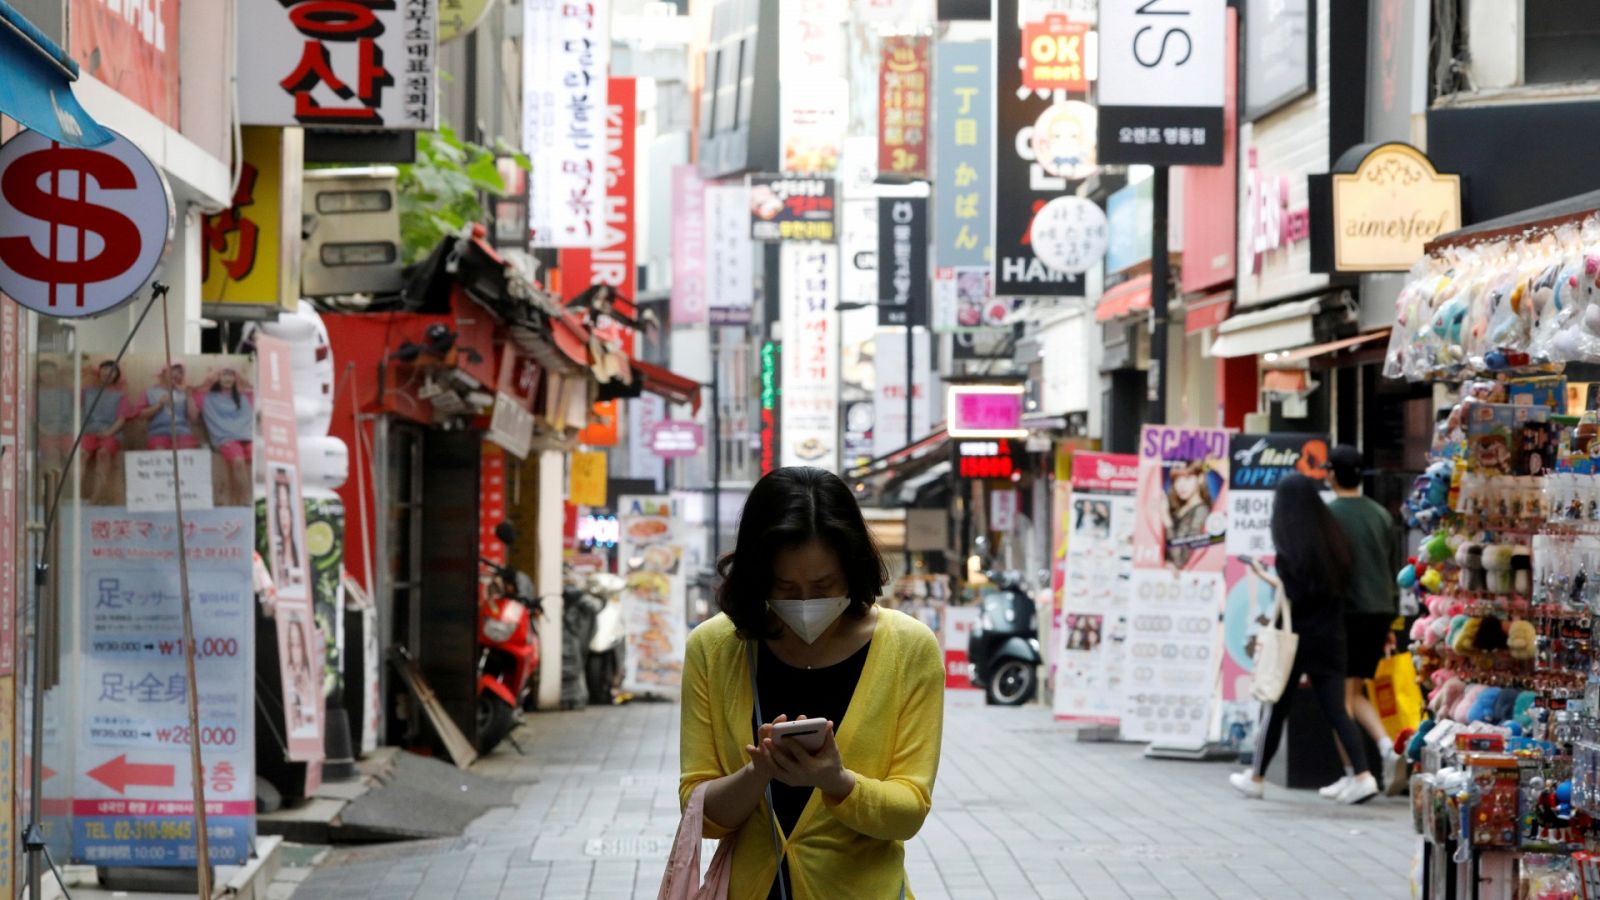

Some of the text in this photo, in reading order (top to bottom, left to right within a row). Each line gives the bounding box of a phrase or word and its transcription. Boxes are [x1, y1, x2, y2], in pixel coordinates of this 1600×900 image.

[1030, 35, 1080, 63] OK
[1033, 64, 1080, 80] mart
[953, 63, 979, 146] 一丁目
[1345, 211, 1449, 237] aimerfeel
[591, 196, 627, 287] HAIR
[1259, 447, 1299, 467] Hair
